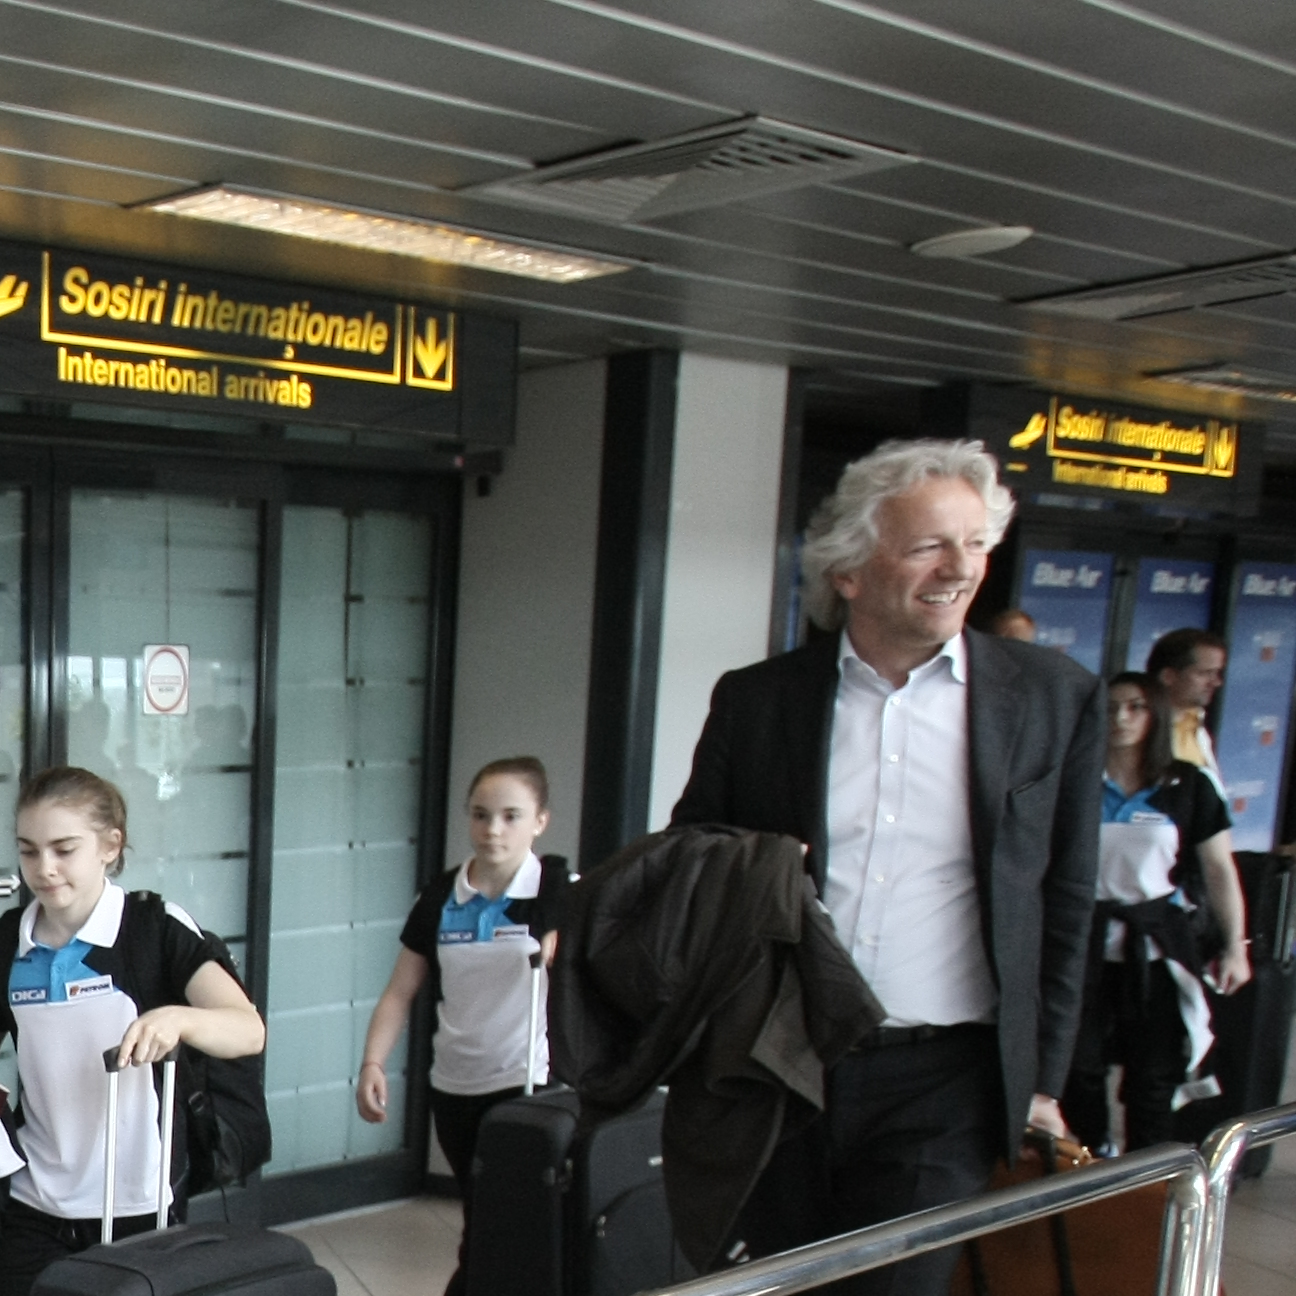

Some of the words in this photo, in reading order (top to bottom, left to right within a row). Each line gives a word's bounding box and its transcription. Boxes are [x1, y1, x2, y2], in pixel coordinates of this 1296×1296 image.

[59, 266, 167, 326] Sosiri
[58, 347, 218, 396] International
[225, 374, 312, 408] arrivals
